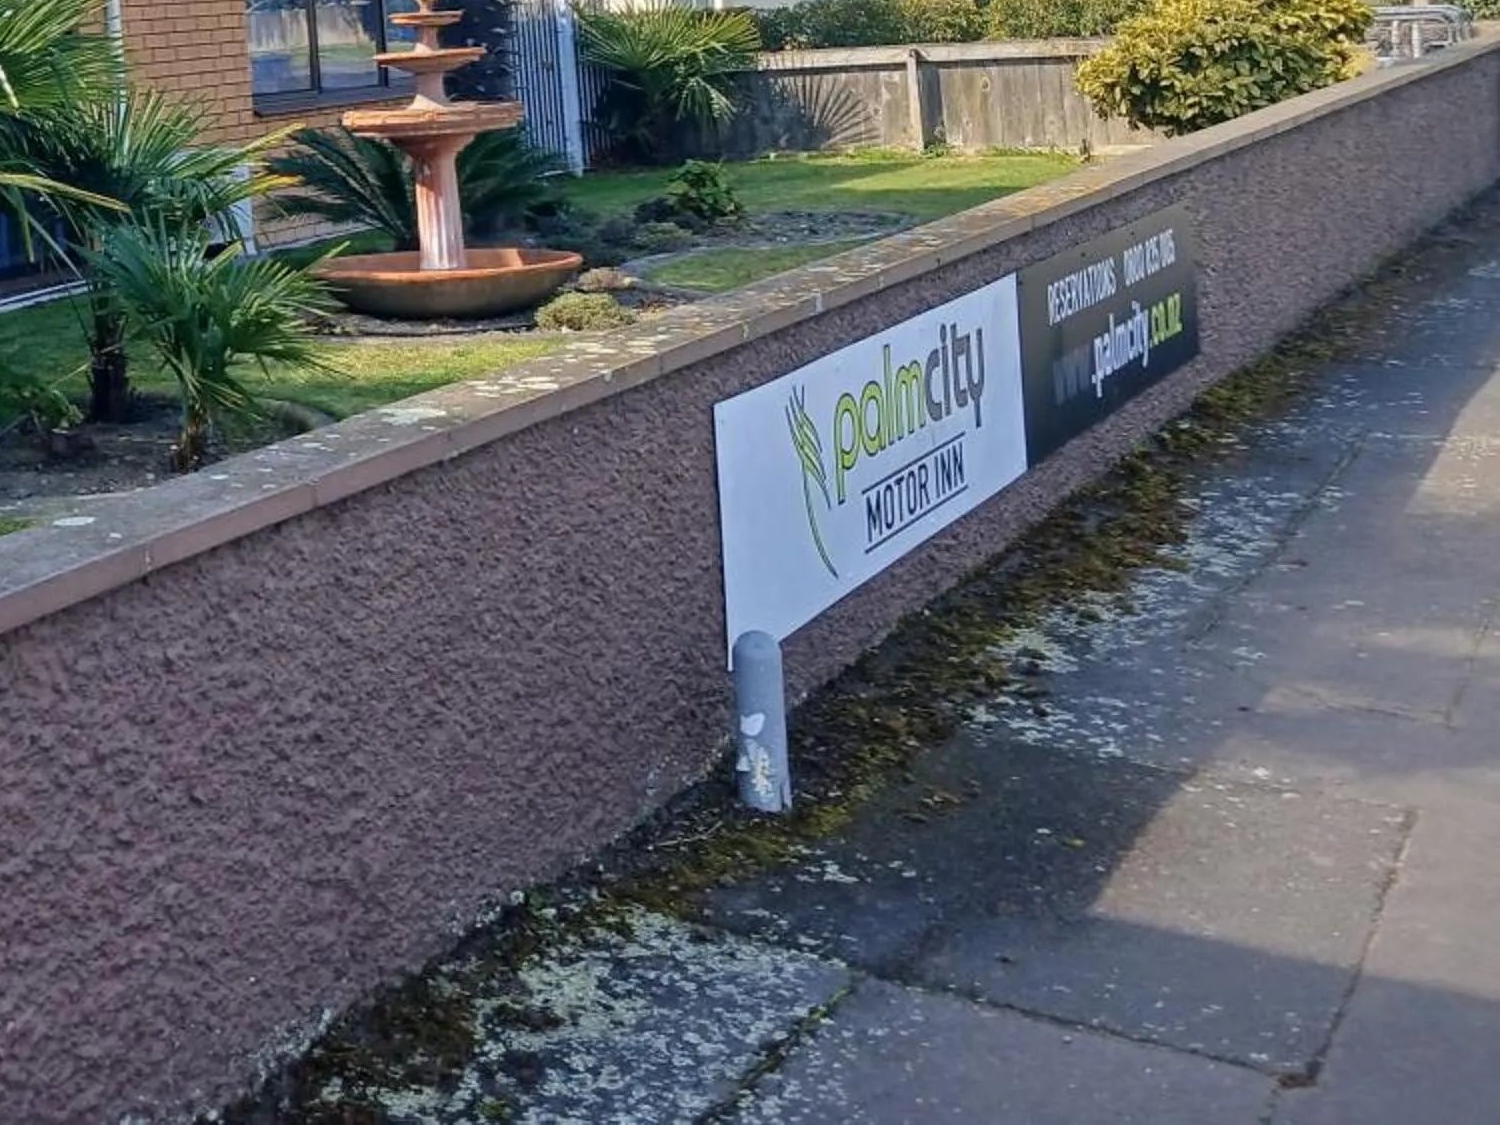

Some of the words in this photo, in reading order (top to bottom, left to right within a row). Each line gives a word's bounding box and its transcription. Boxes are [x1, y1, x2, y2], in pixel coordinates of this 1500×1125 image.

[833, 323, 985, 506] palmcity
[866, 465, 929, 543] MOTOR
[935, 442, 965, 499] INN
